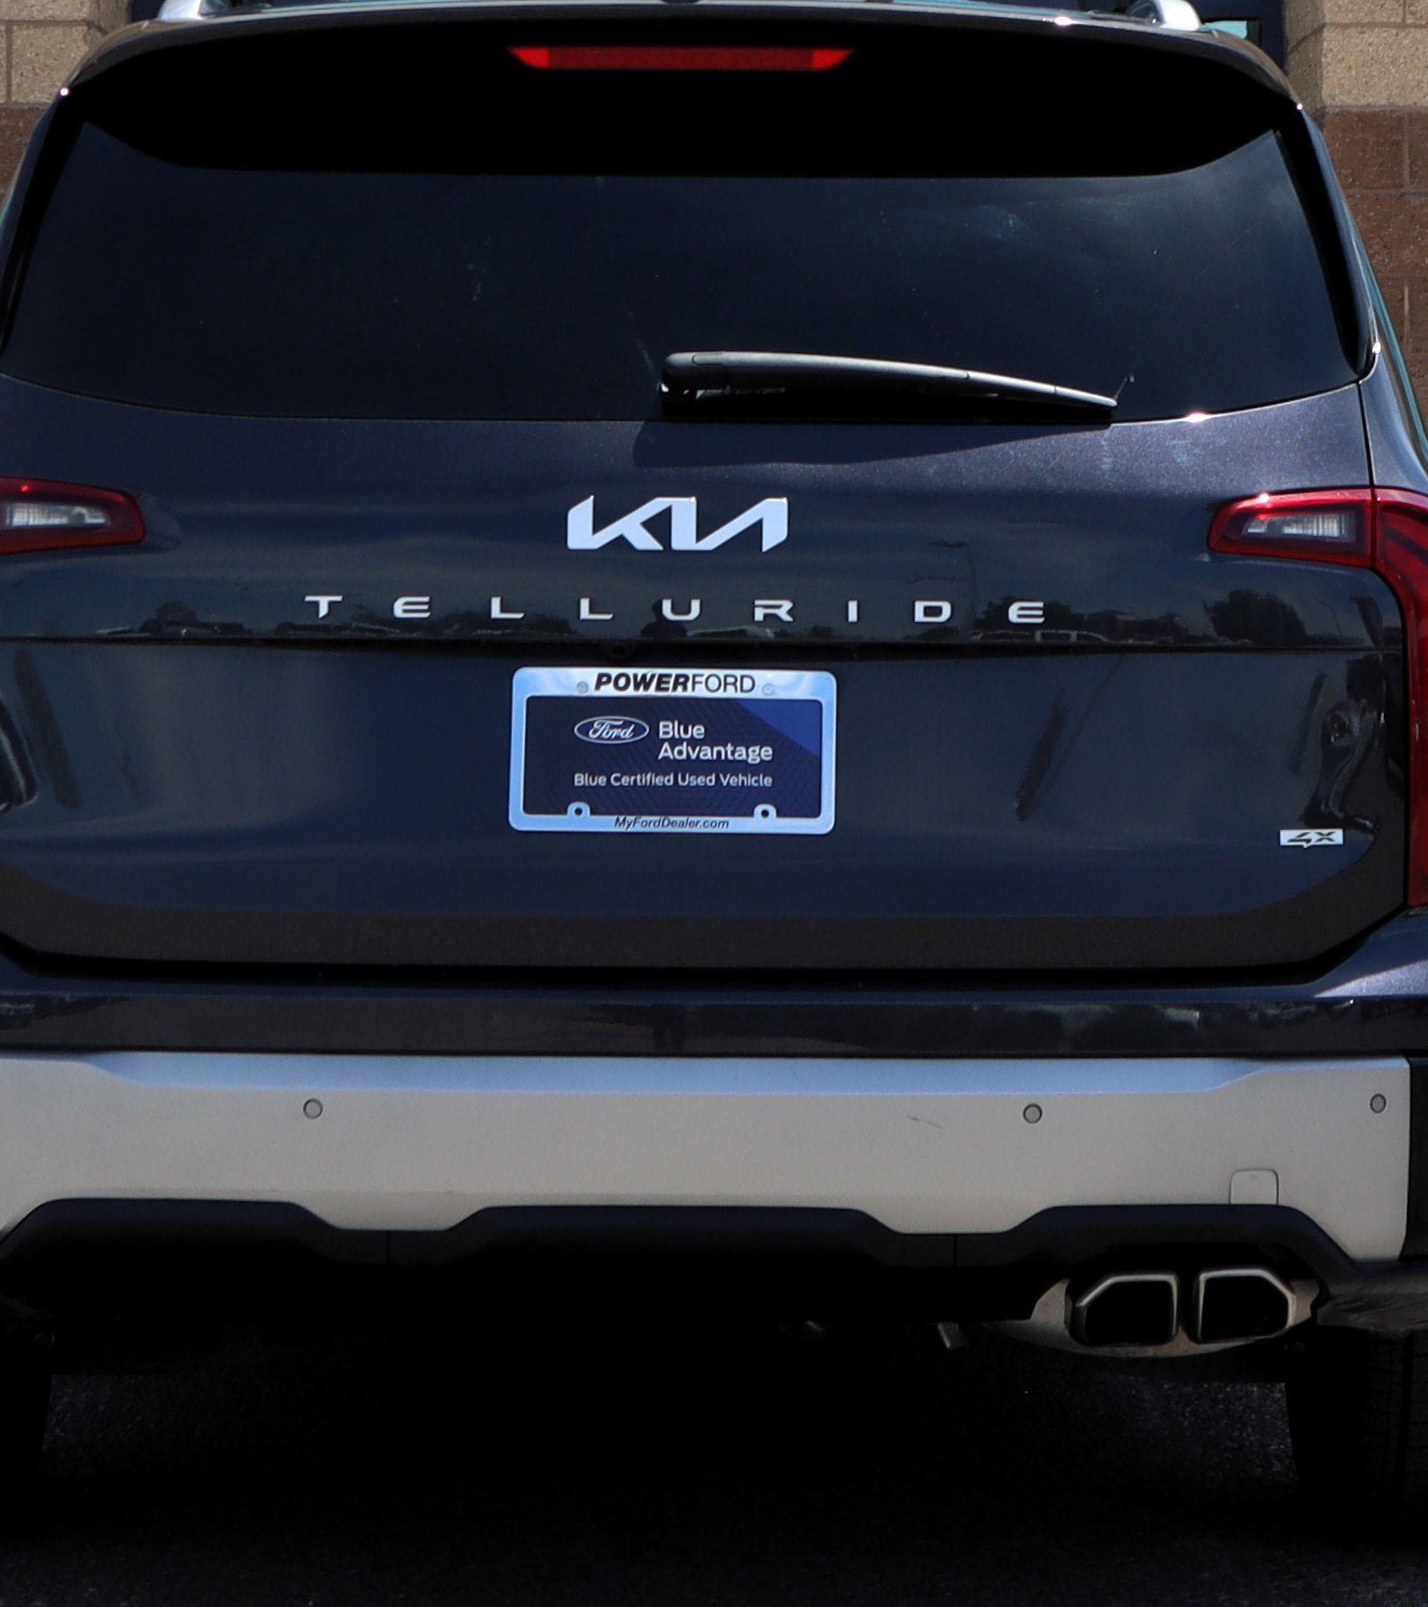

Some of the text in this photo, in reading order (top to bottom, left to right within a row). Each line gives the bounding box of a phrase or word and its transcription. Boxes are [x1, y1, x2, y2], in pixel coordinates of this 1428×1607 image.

[567, 495, 788, 552] KIA
[304, 594, 1046, 625] TELLURIDE
[593, 672, 756, 694] POWERFORD
[588, 720, 635, 740] Ford
[658, 721, 705, 739] Blue
[658, 743, 773, 764] Advantage
[574, 773, 772, 788] Blue Certified Used Vehicle
[614, 816, 730, 830] MyFordDealer.com
